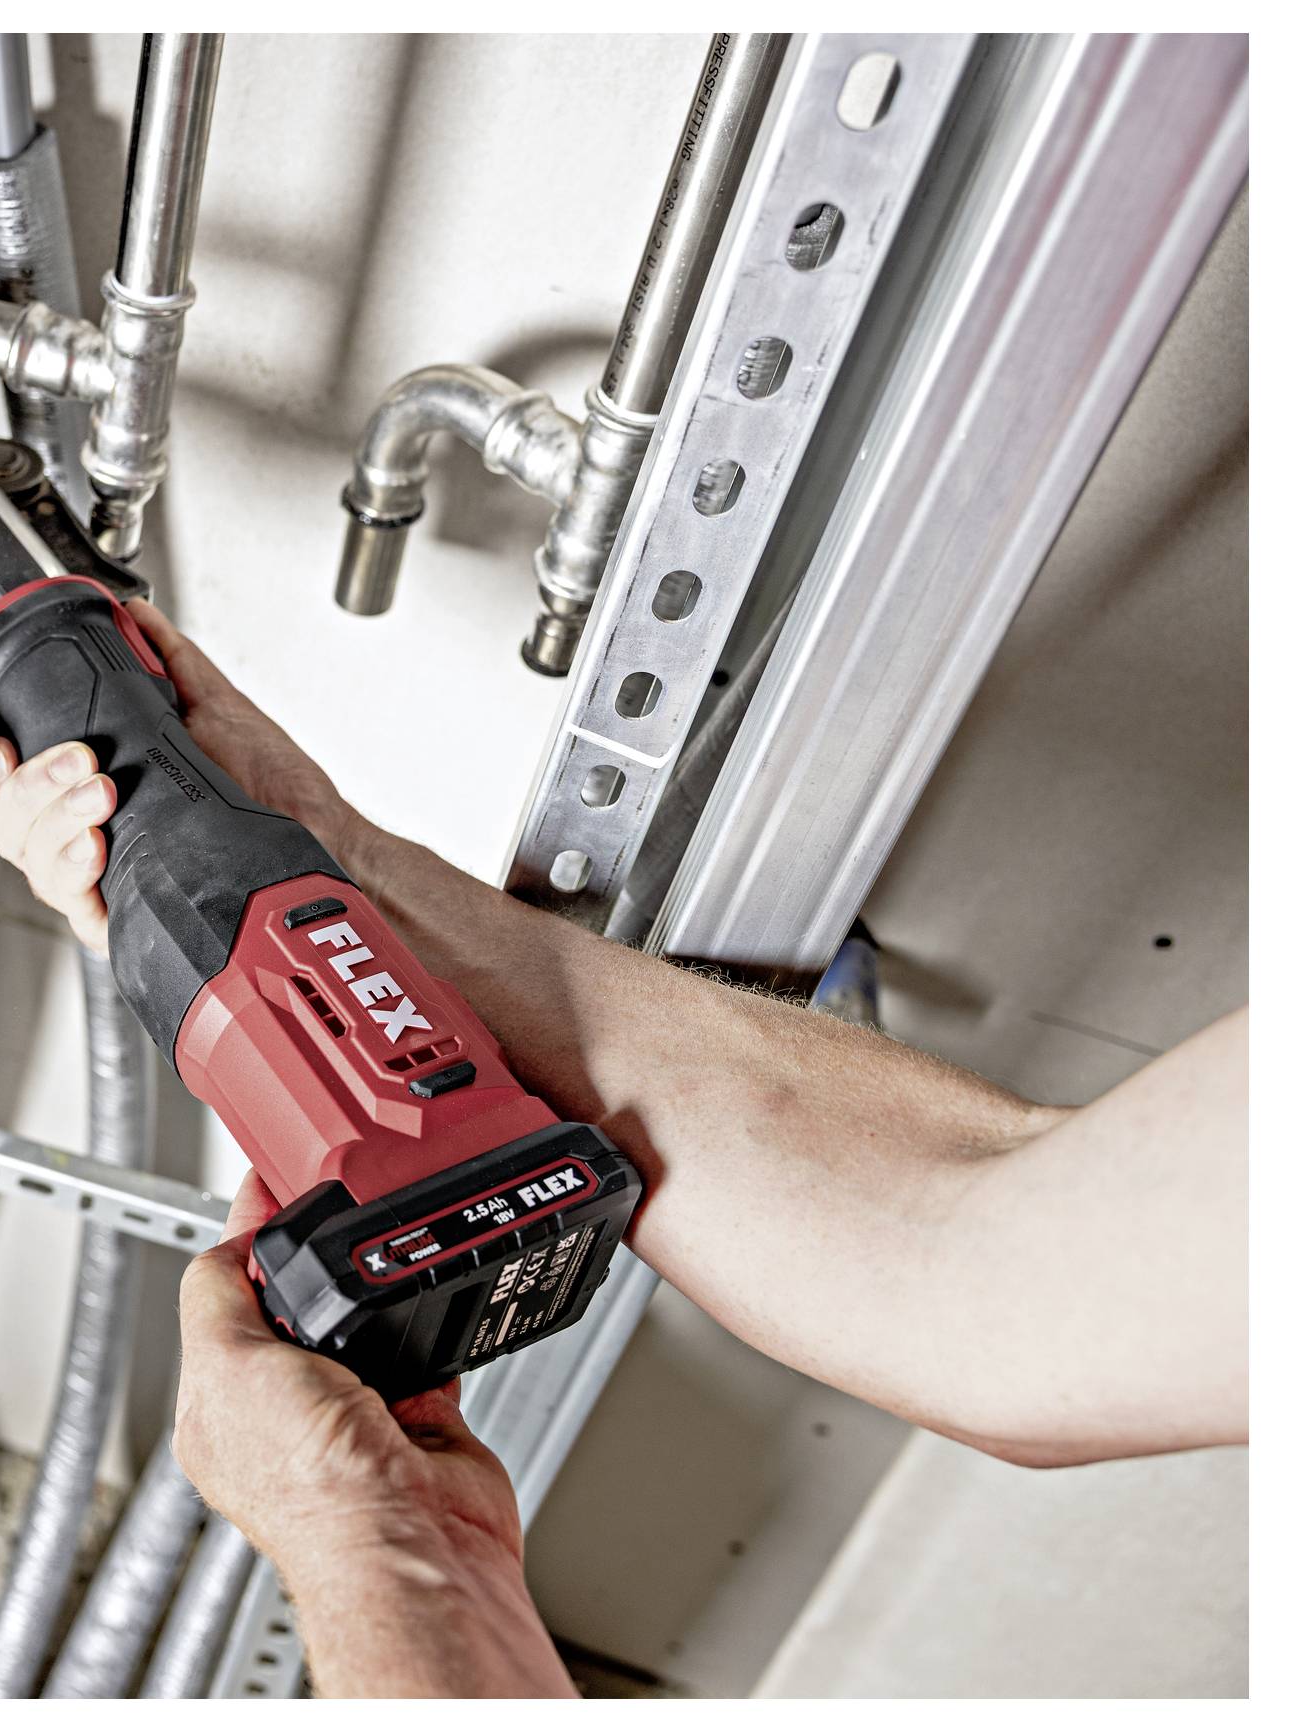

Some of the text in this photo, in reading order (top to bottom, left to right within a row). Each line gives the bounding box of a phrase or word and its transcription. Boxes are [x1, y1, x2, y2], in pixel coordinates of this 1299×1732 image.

[682, 33, 731, 161] PRESSFITTING
[146, 747, 206, 802] BRUSHLESS
[308, 921, 433, 1044] FLEX
[517, 1167, 584, 1208] FLEX
[493, 1209, 516, 1225] 18V
[408, 1242, 443, 1262] POWER
[490, 1258, 524, 1304] FLEX
